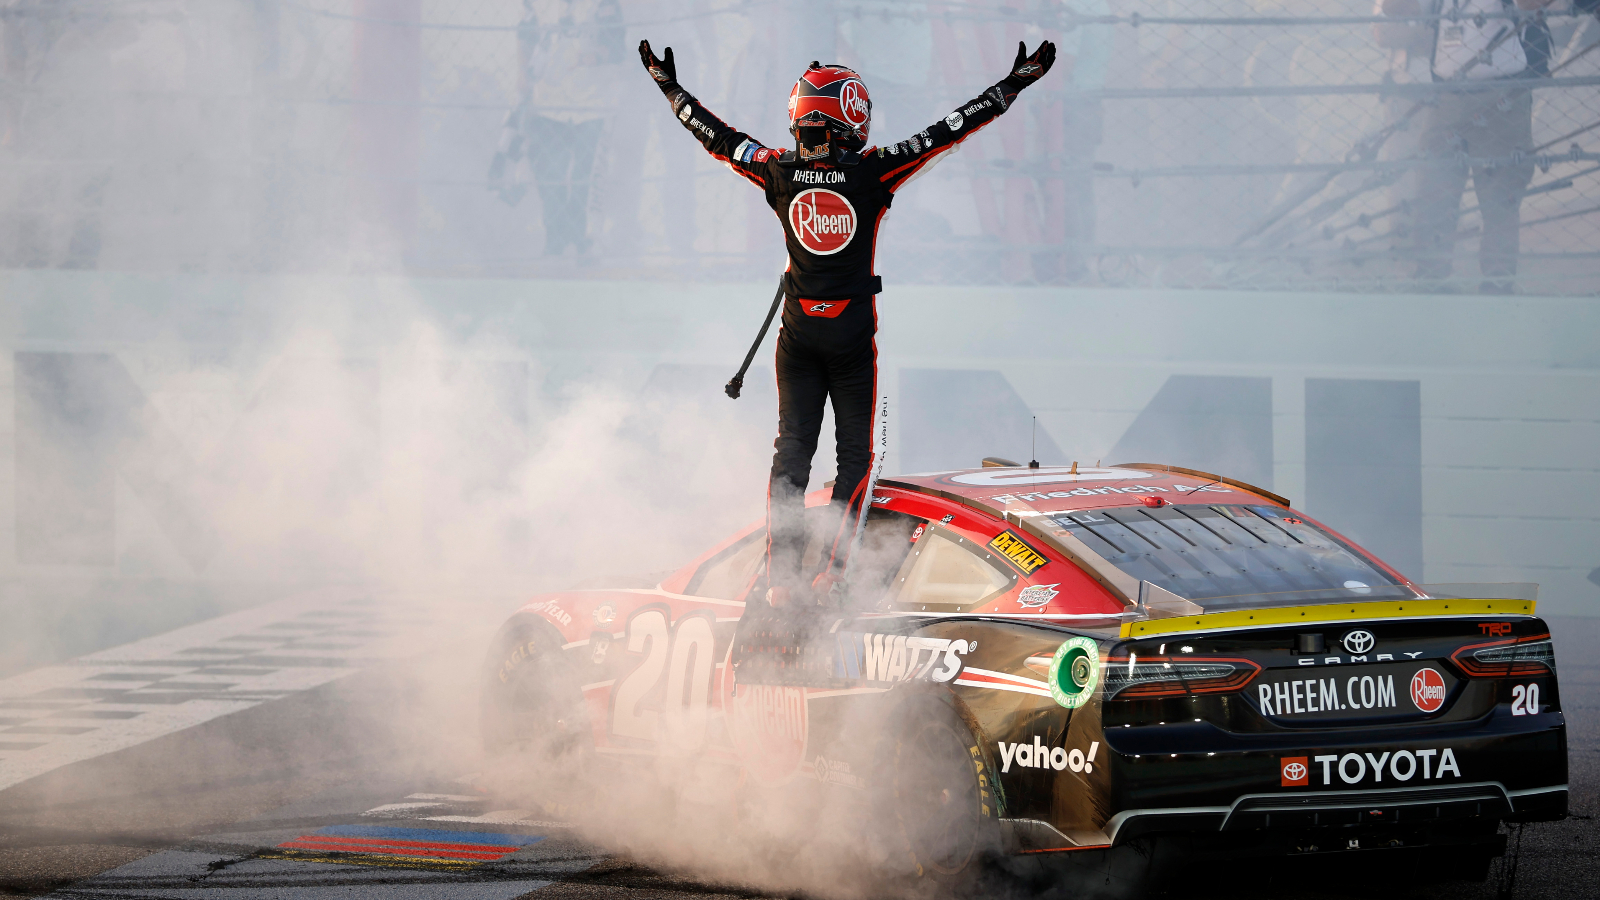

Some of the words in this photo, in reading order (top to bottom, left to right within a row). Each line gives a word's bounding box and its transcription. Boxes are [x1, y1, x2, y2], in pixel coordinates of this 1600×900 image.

[793, 169, 846, 184] RHEEM.COM
[798, 192, 851, 243] Rheem
[991, 483, 1169, 504] Friedrich
[1478, 622, 1511, 637] TRD
[499, 641, 537, 683] EAGLE
[863, 633, 967, 683] WATTS
[1298, 652, 1422, 666] CAMRY
[611, 610, 715, 750] 20
[1258, 675, 1396, 716] RHEEM.COM
[1413, 668, 1444, 707] Rheem
[1511, 683, 1539, 716] 20
[998, 736, 1099, 773] yahoo!
[1314, 748, 1461, 785] TOYOTA
[970, 745, 990, 818] EAGLE
